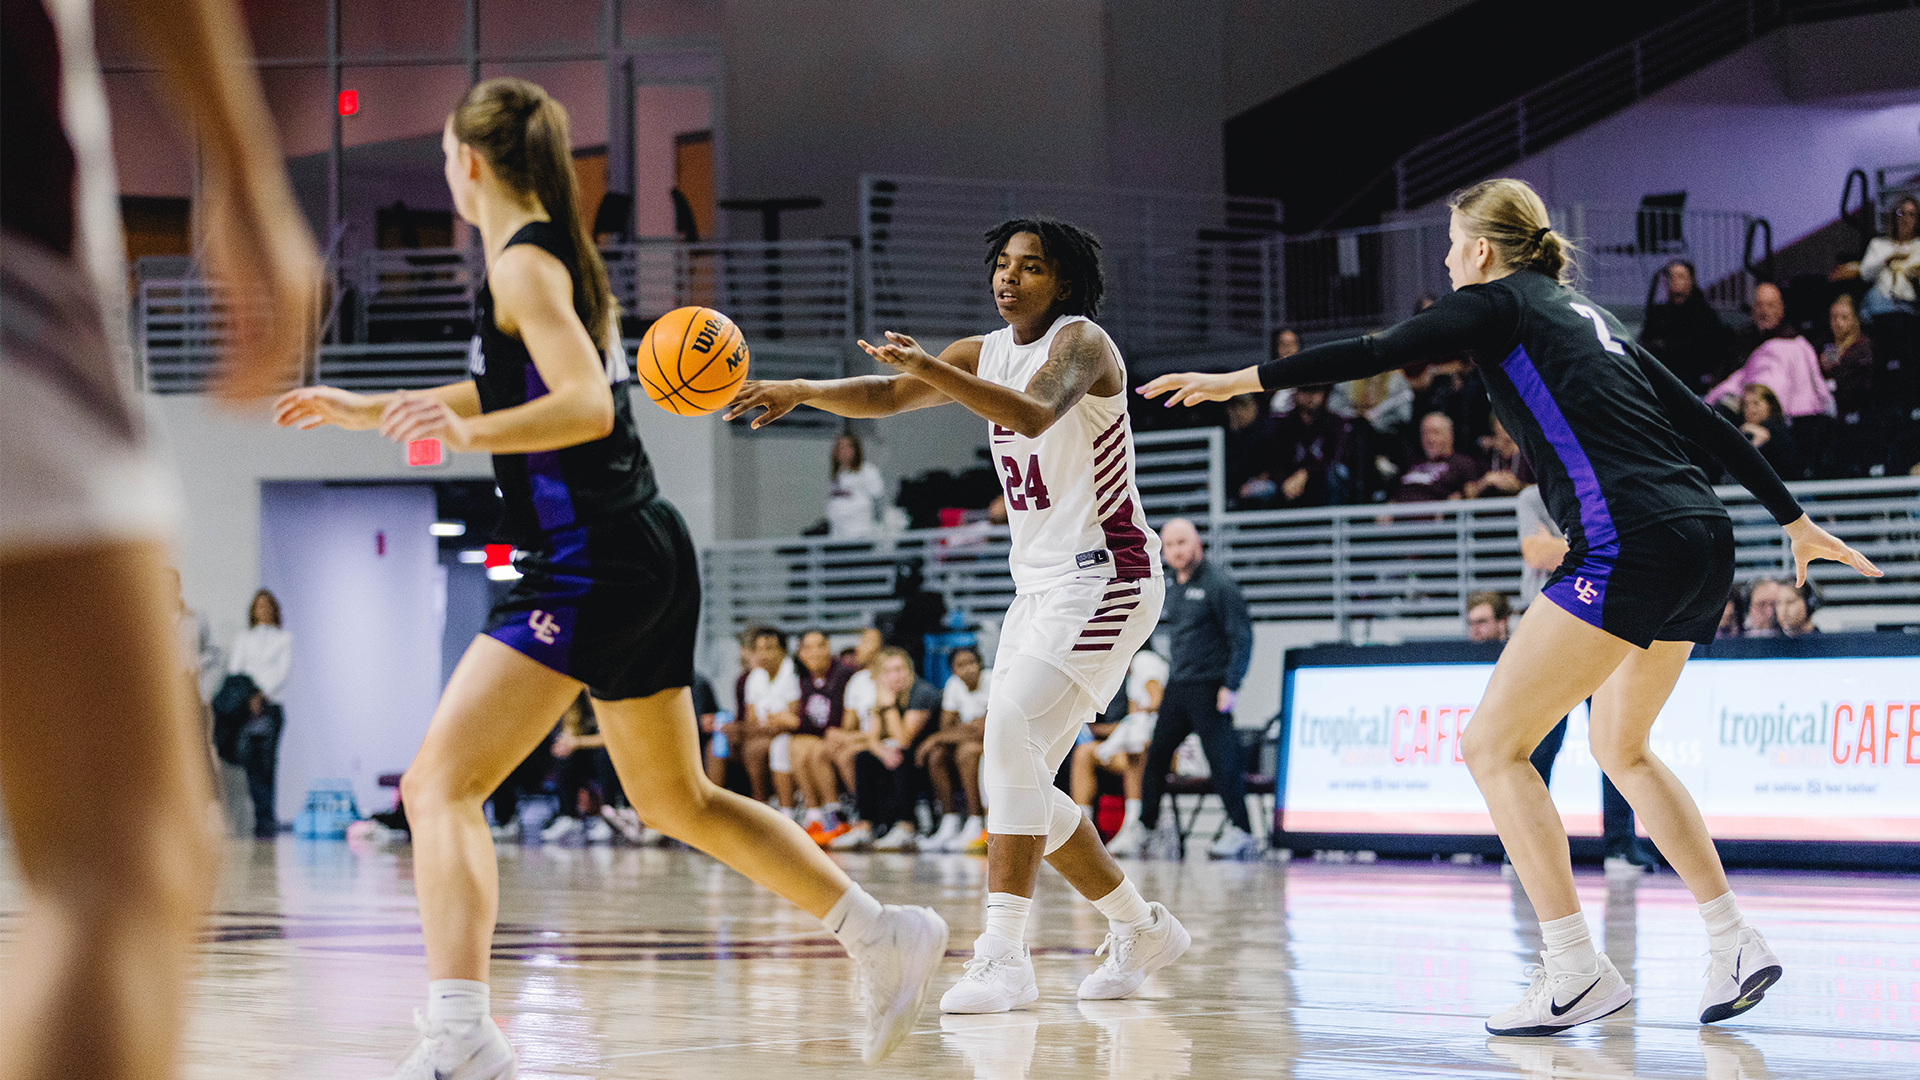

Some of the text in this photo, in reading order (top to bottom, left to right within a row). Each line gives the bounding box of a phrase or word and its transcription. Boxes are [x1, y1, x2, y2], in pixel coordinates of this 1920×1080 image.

[1569, 302, 1625, 355] 2
[1001, 454, 1051, 511] 24
[1574, 576, 1598, 605] UE
[1299, 706, 1473, 764] tropical CAFE
[1719, 702, 1920, 764] tropical CAFE
